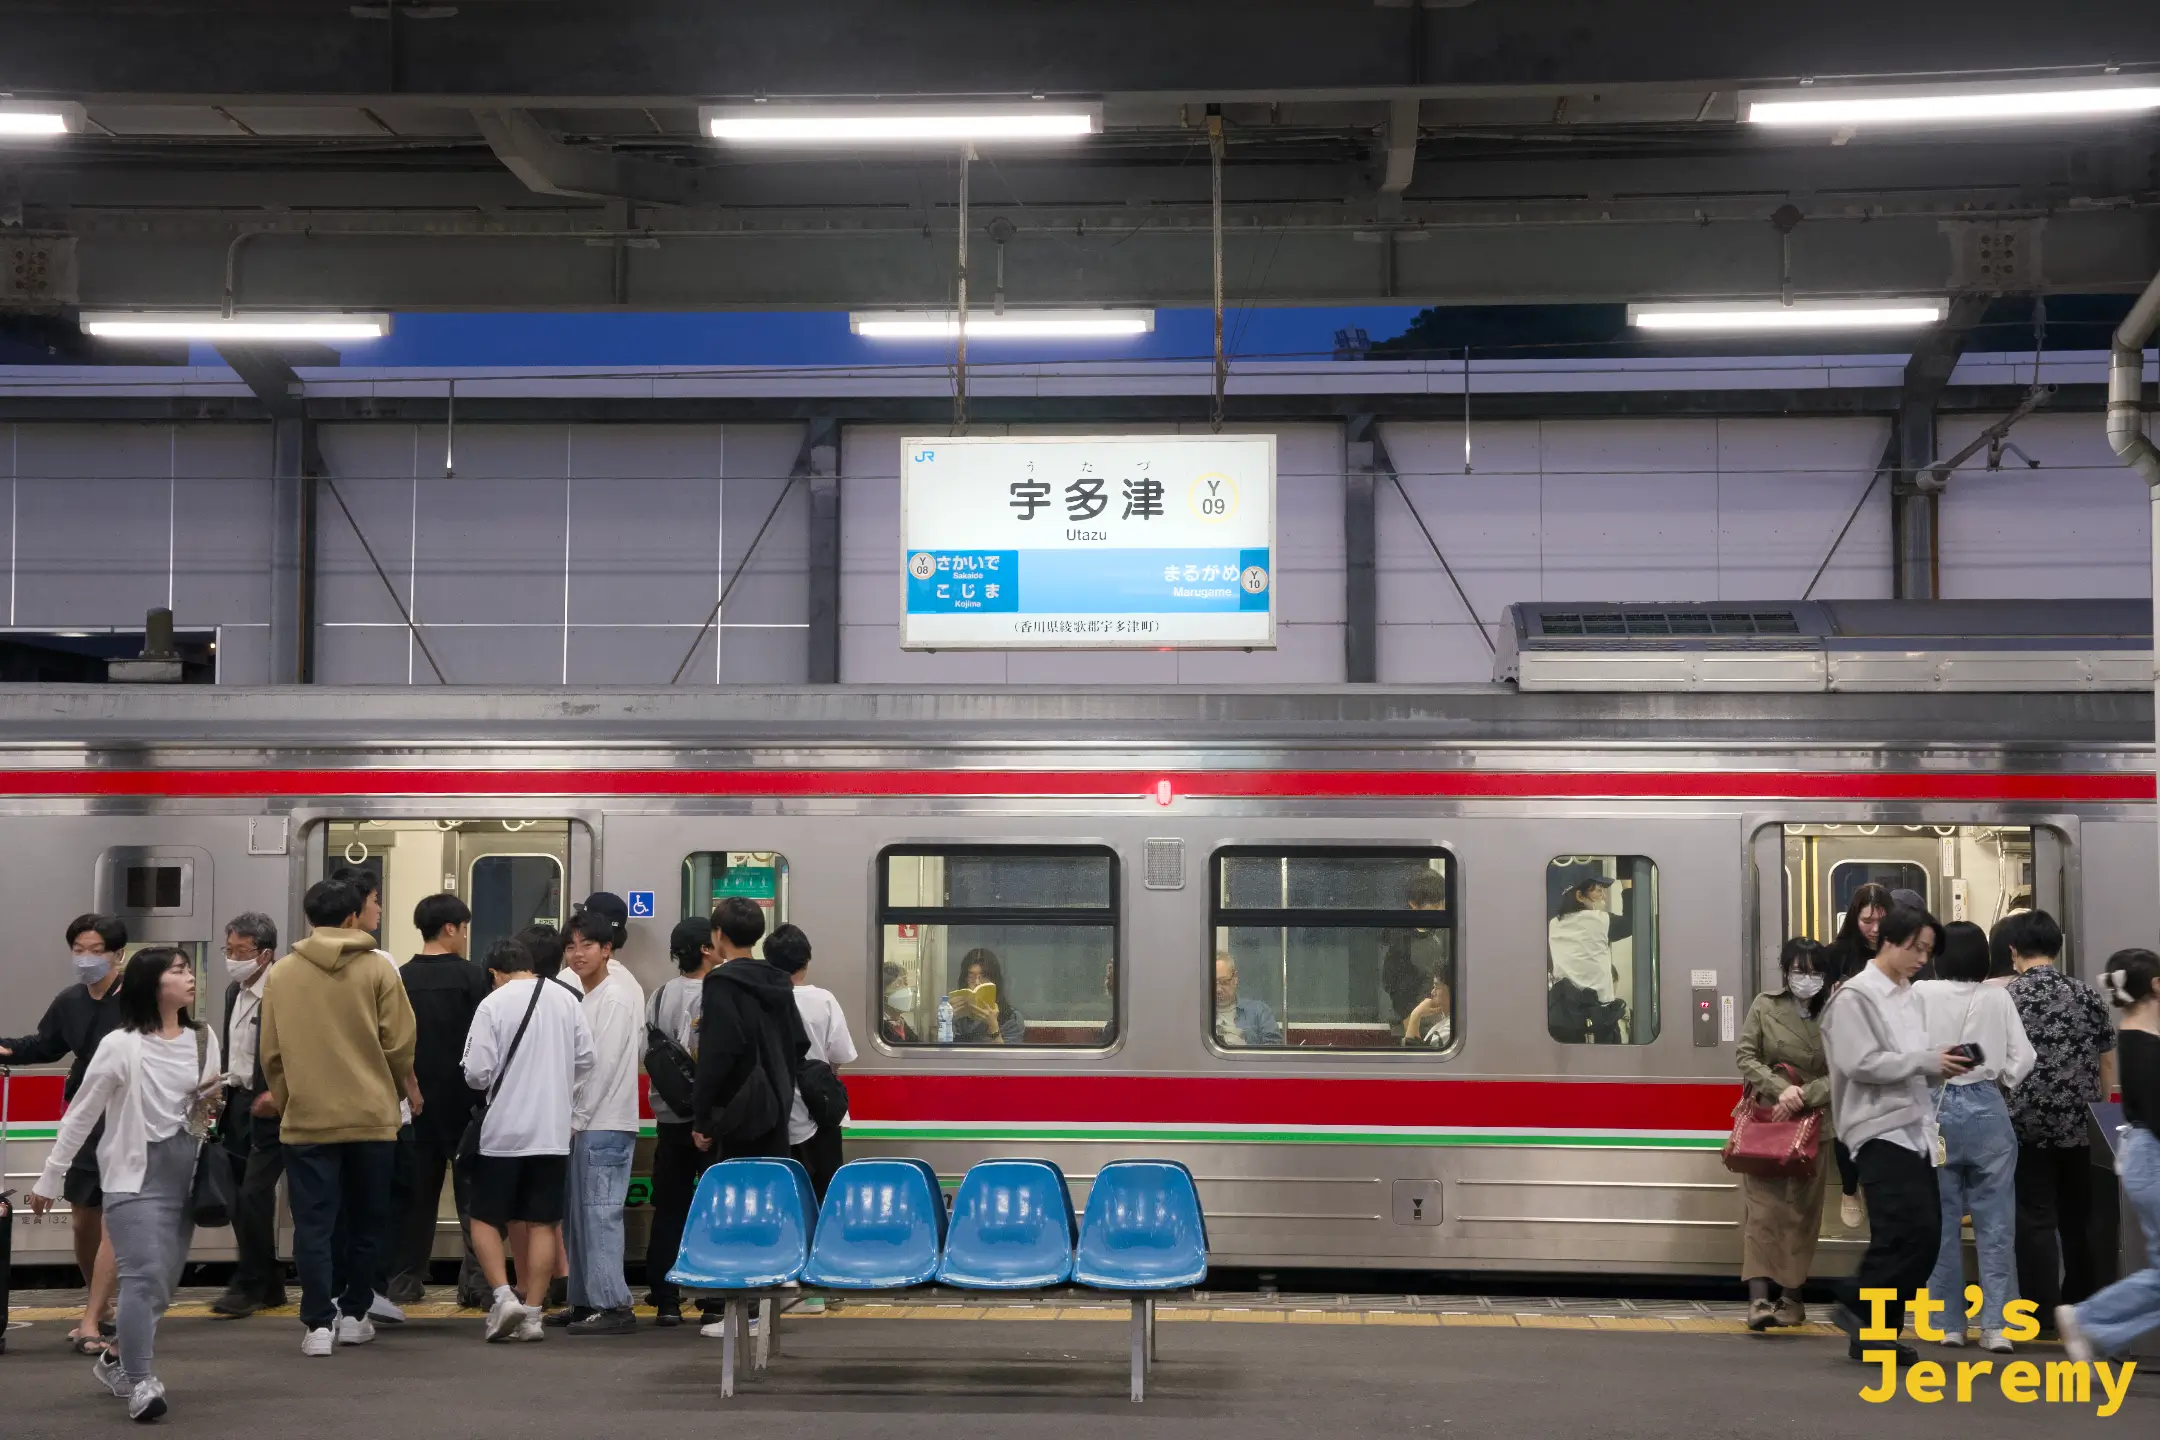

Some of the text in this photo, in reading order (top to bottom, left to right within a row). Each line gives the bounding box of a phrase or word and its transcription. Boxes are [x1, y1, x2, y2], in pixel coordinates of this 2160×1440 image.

[915, 451, 935, 462] JR
[1026, 460, 1151, 473] うたづ
[1207, 480, 1220, 496] Y
[1009, 478, 1165, 521] 宇多津
[1202, 498, 1225, 515] 09
[1066, 529, 1107, 541] Utazu
[919, 557, 926, 565] Y
[936, 555, 1000, 571] さかいで
[916, 566, 929, 575] 08
[952, 572, 984, 580] Sakaide
[1163, 564, 1240, 582] まるがめ
[1250, 571, 1258, 579] Y
[1249, 580, 1260, 589] 10
[936, 583, 1000, 599] こじま
[1173, 587, 1233, 599] Marugame
[954, 600, 982, 609] Kojima
[48, 1216, 68, 1225] 132
